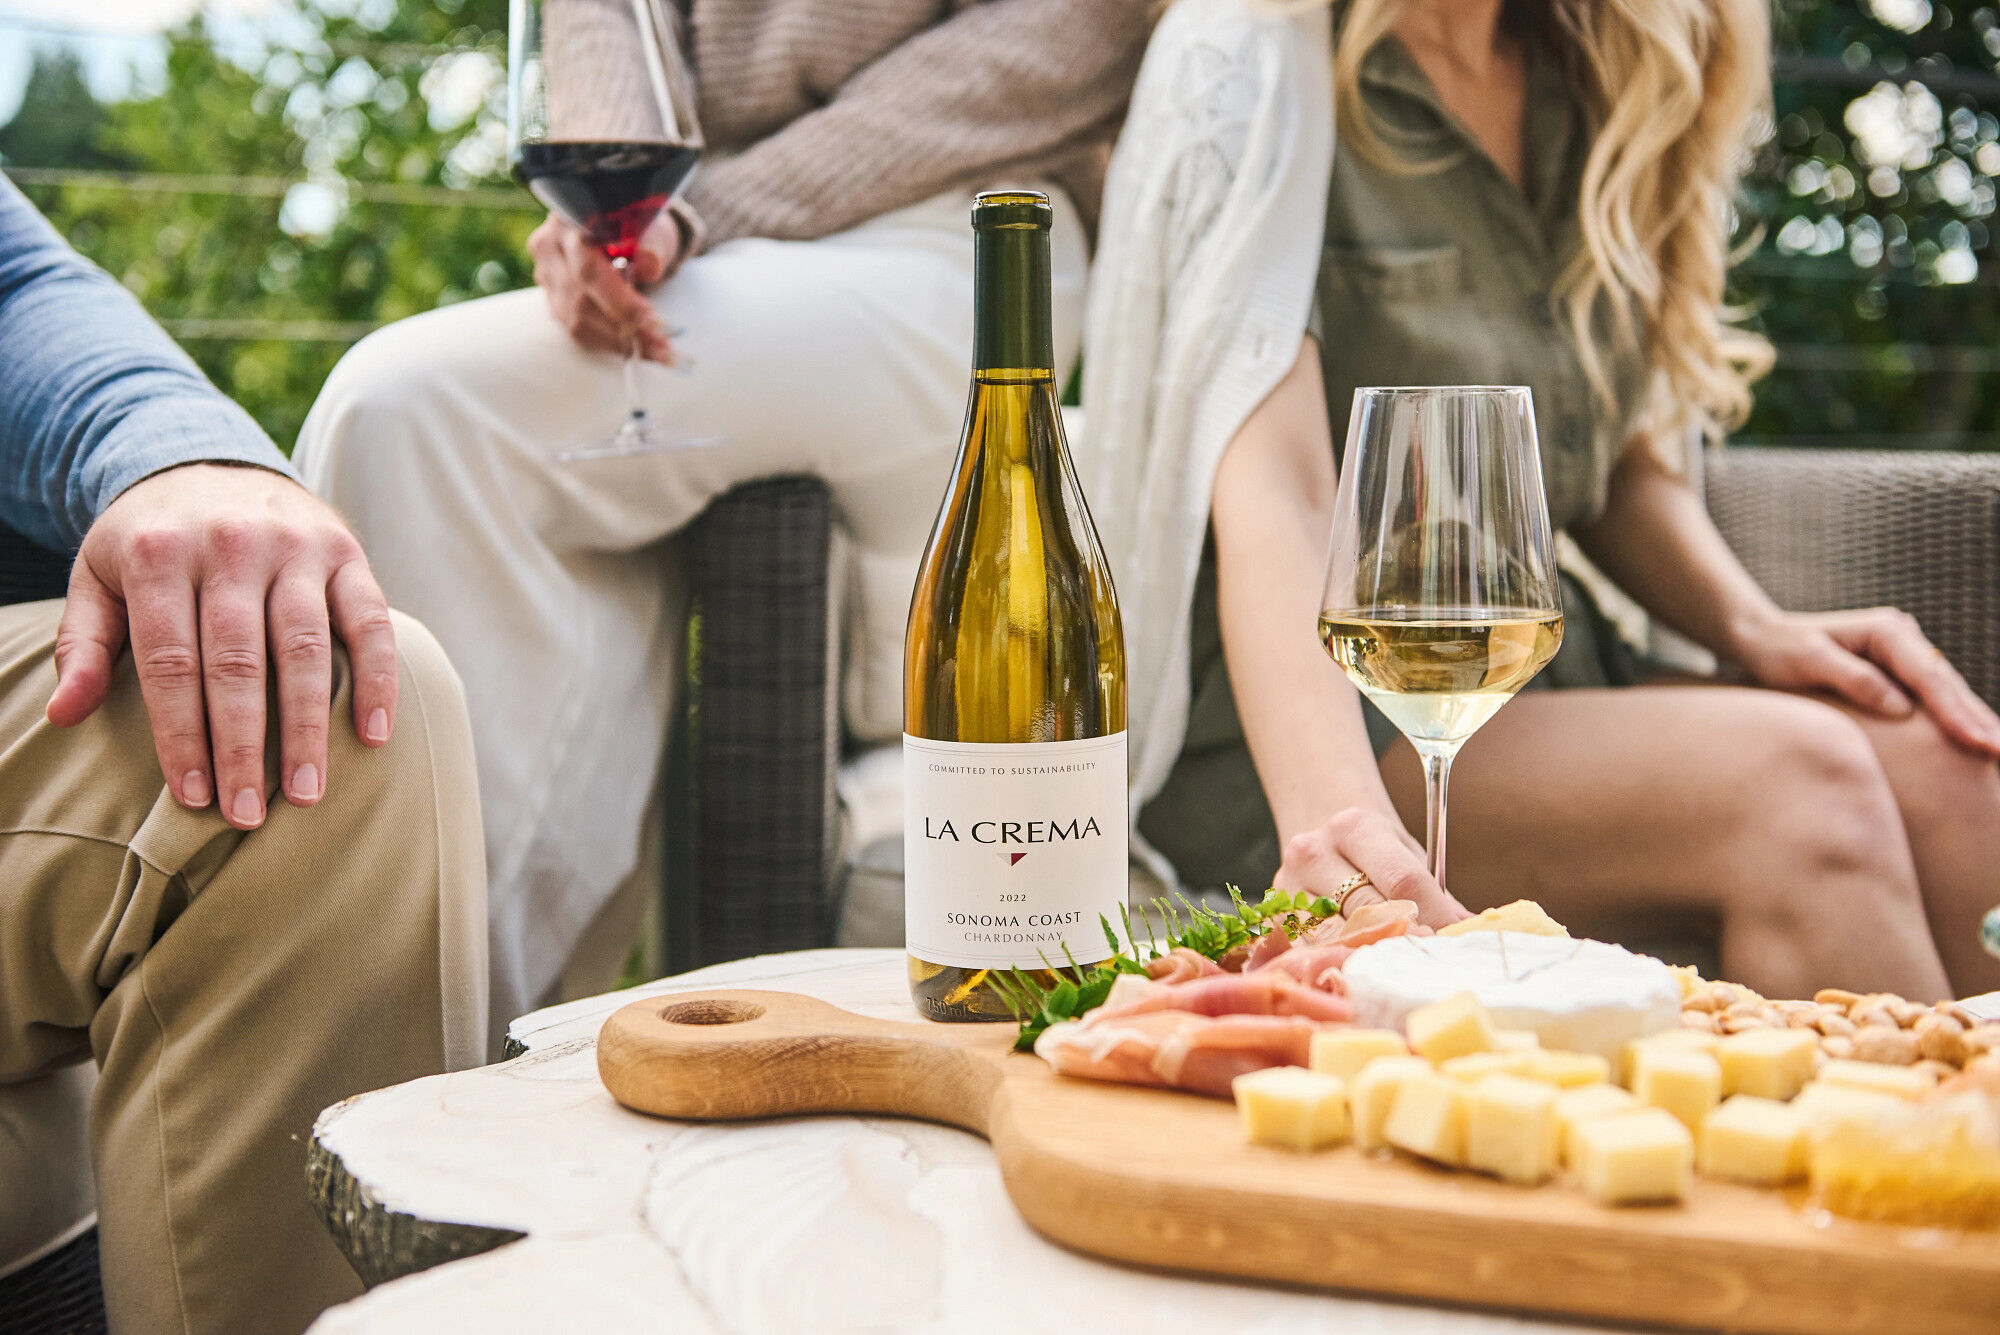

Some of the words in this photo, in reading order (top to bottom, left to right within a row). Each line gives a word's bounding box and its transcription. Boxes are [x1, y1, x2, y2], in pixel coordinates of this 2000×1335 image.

[928, 763, 986, 775] COMMITTED
[990, 767, 1005, 775] TO
[1011, 762, 1096, 775] SUSTAINABILITY
[925, 816, 960, 842] LA
[971, 816, 1102, 844] CREMA
[999, 894, 1027, 902] 2022
[947, 912, 1020, 927] SONOMA
[1028, 911, 1081, 927] COAST
[964, 931, 1063, 943] CHARDONNAY
